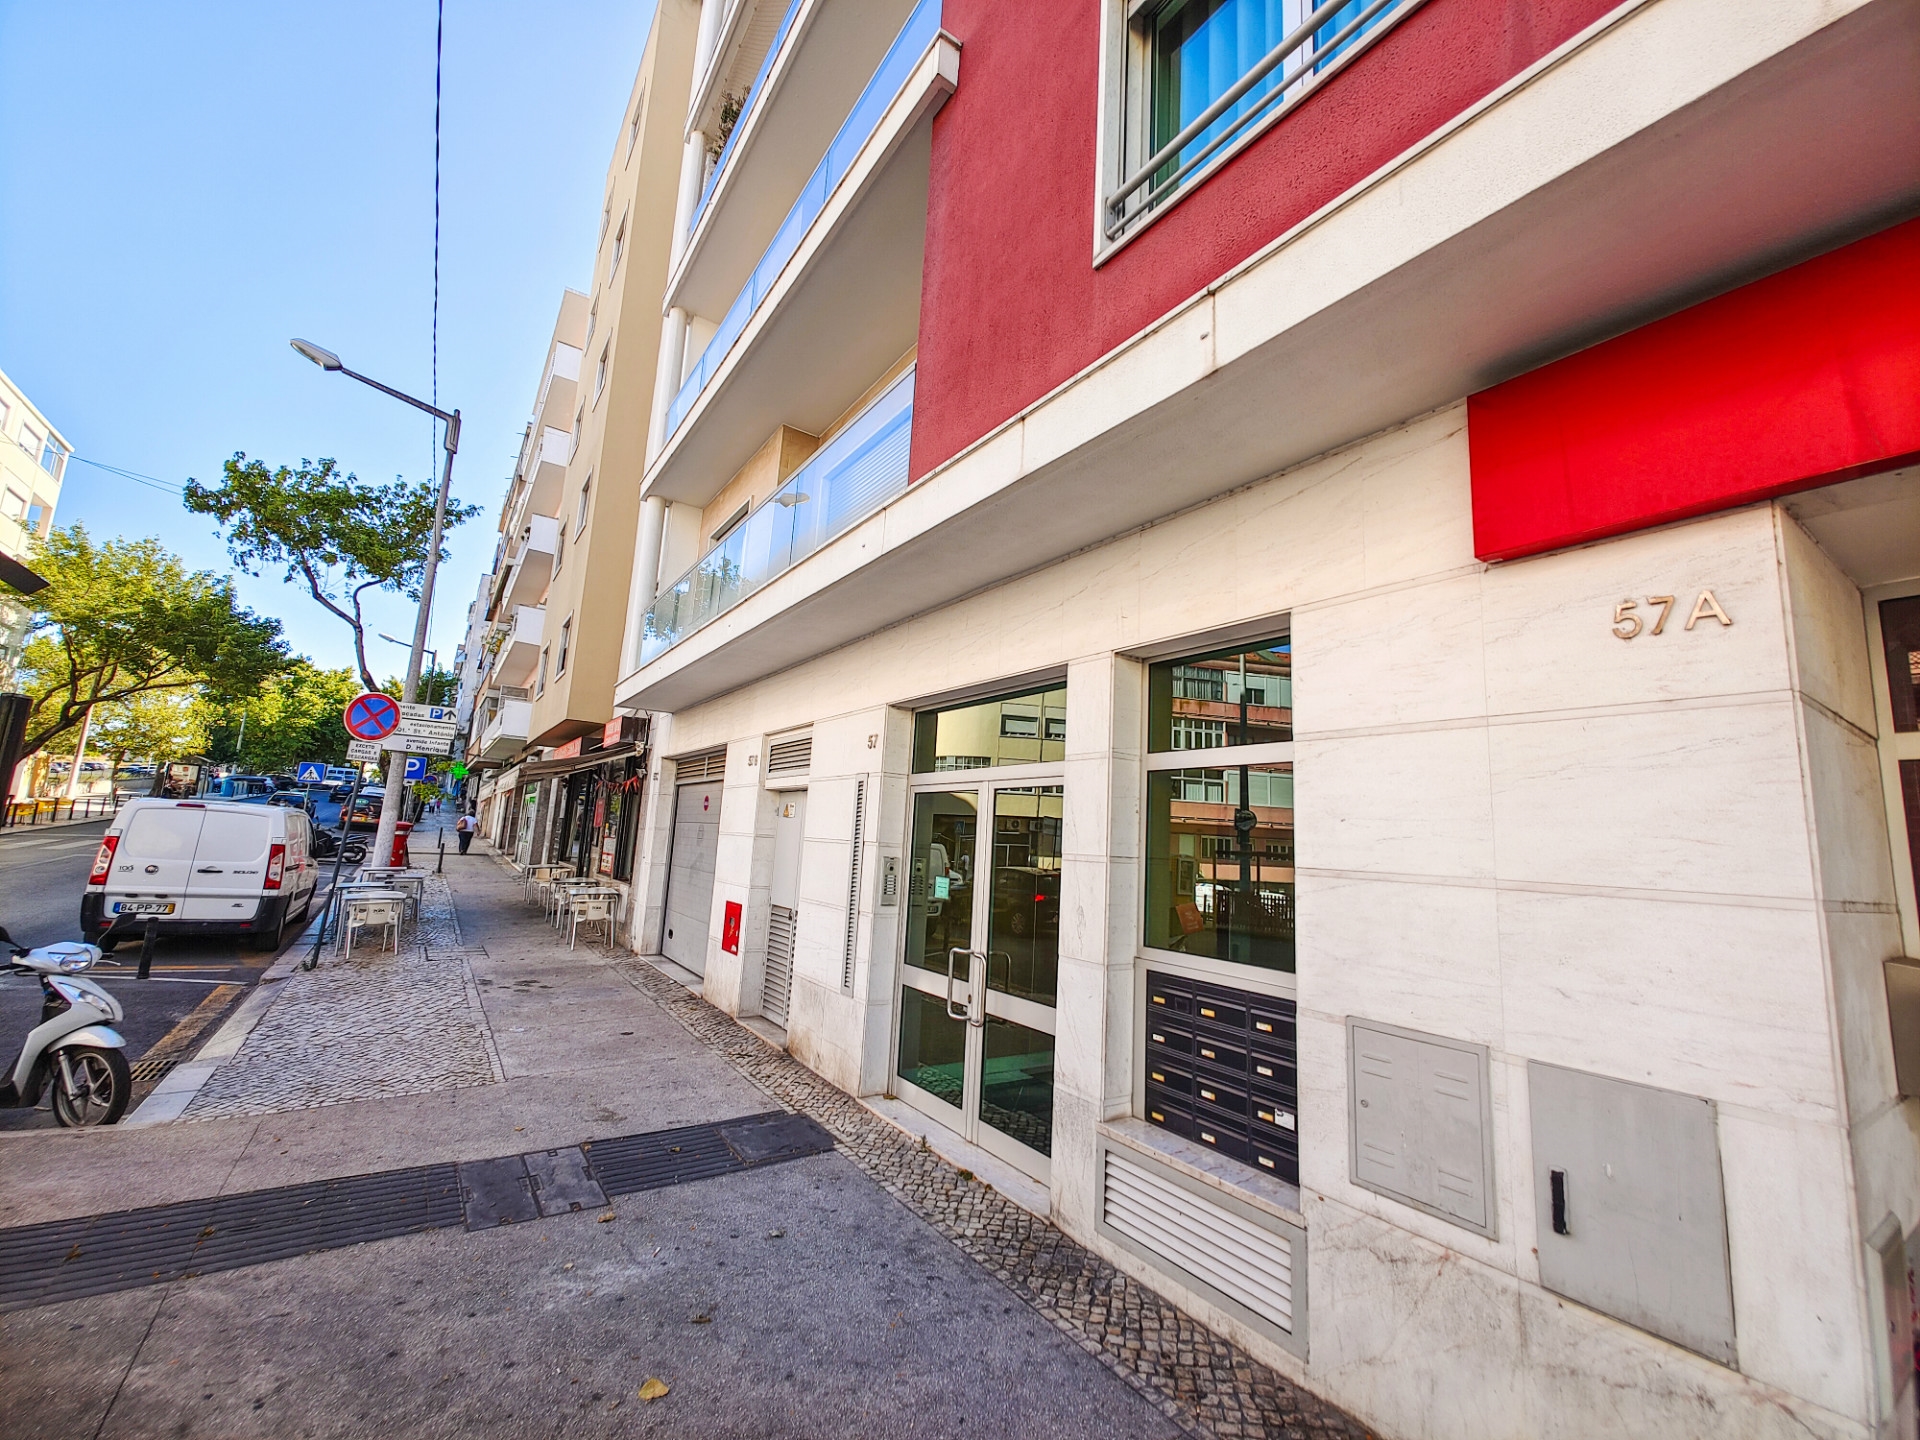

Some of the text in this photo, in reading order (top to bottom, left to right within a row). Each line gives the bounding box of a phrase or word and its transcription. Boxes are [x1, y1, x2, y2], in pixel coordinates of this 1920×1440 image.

[867, 734, 878, 749] 57
[416, 745, 448, 753] Henrique
[120, 903, 169, 912] 84-PP-77
